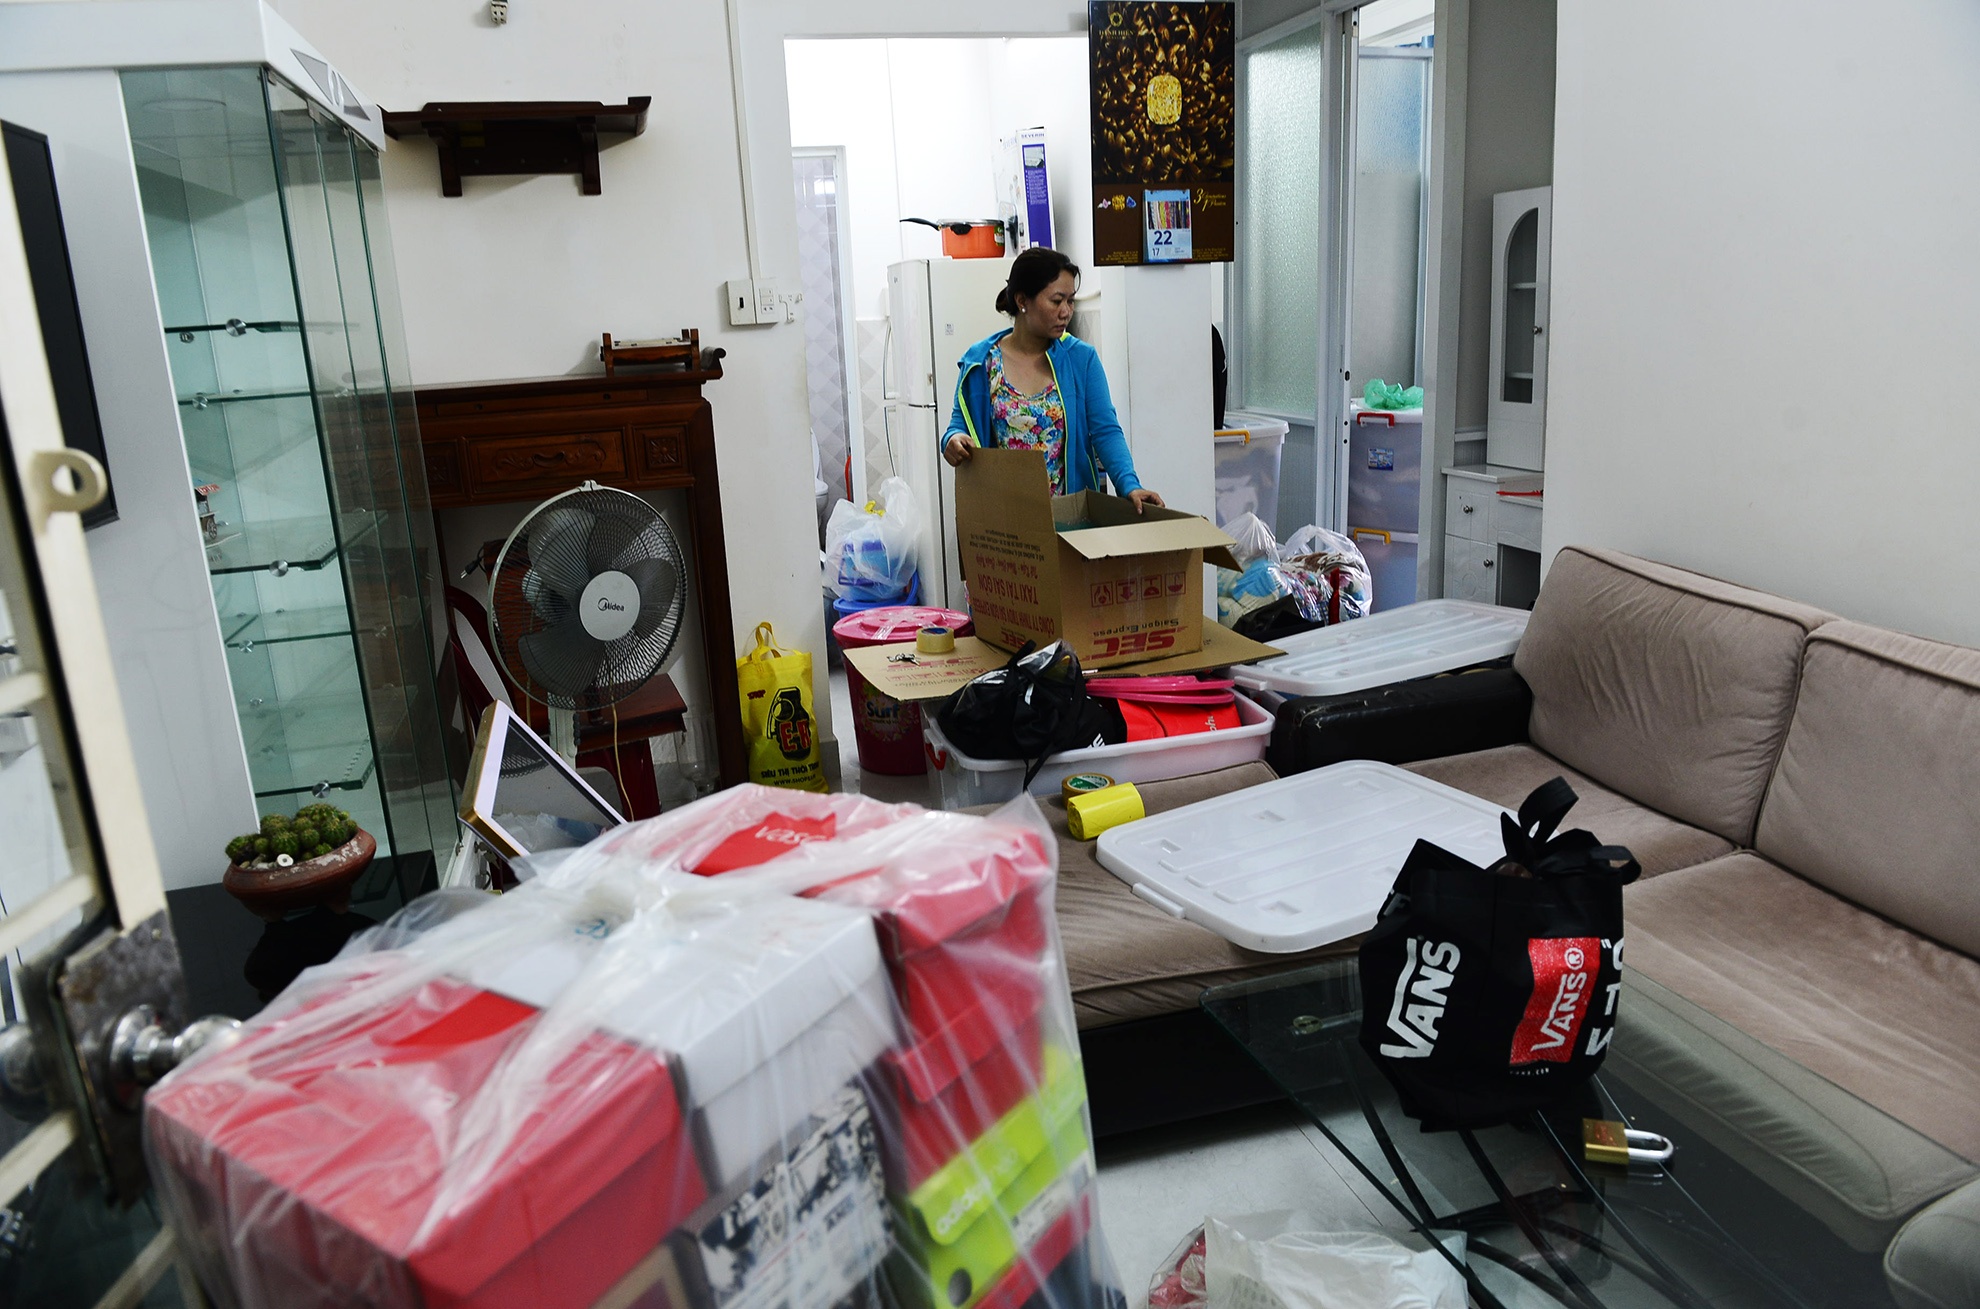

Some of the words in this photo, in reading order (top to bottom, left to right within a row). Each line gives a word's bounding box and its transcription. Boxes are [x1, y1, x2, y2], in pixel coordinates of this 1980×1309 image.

[1193, 187, 1204, 204] 3
[1153, 230, 1172, 245] 22
[1152, 247, 1160, 256] 17
[977, 573, 993, 596] GÒN
[993, 577, 1005, 600] SÀI
[1006, 581, 1019, 606] TẢI
[1020, 584, 1038, 605] TAXI
[598, 597, 625, 611] Midea
[1093, 624, 1139, 637] Express
[1141, 618, 1178, 629] Saigon
[1084, 627, 1183, 661] SEC
[866, 701, 901, 720] Surf
[1380, 937, 1461, 1058] VANS
[1530, 971, 1588, 1052] VANS
